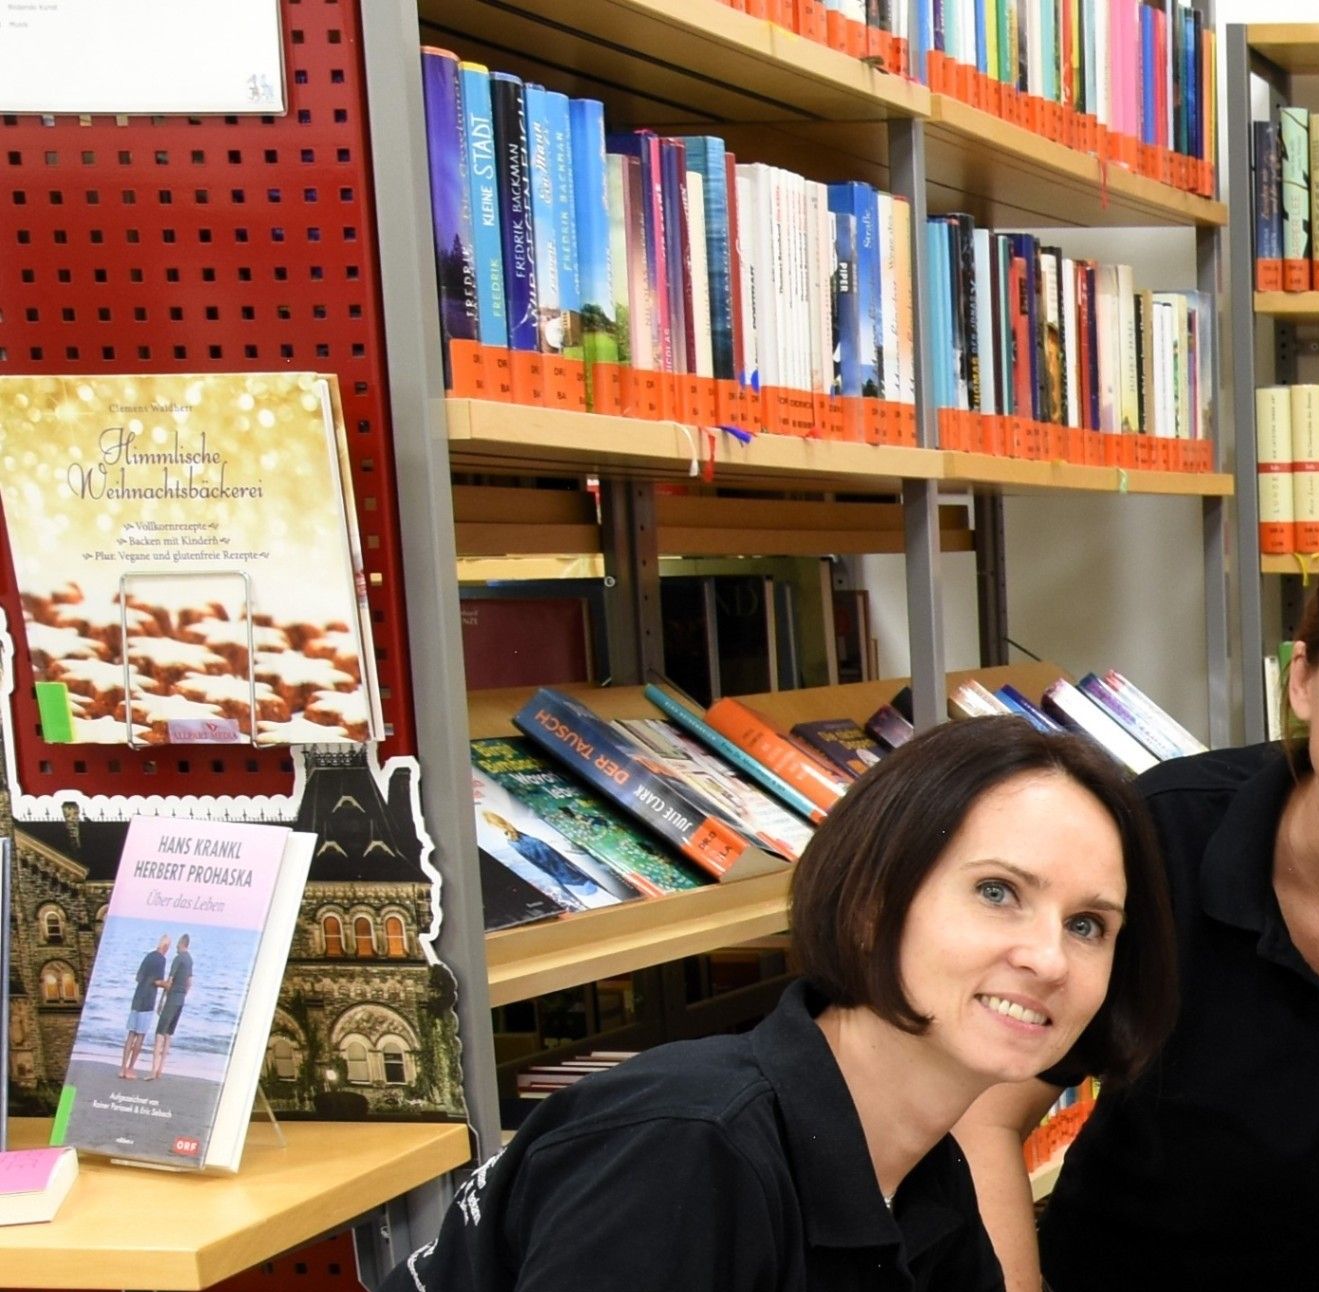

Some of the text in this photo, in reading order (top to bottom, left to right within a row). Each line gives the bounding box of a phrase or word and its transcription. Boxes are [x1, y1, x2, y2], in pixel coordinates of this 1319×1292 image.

[470, 112, 495, 227] KLEINE STADT
[508, 144, 526, 278] FREDRIK BACKMAN
[862, 209, 873, 249] Straße
[489, 259, 502, 317] FREDRIK
[840, 262, 849, 292] PIPER
[98, 427, 221, 466] Himmlische
[66, 460, 264, 501] Weihnachtsbäckerei
[129, 536, 161, 546] Backen
[163, 536, 179, 546] mit
[135, 521, 207, 534] Vollkornrezepte
[120, 549, 259, 564] Vegane und glutenfreie Rezepte
[533, 709, 595, 760] TAUSCH
[593, 753, 630, 786] DER
[632, 784, 693, 833] JULIE CLARK
[158, 835, 243, 860] HANS KRANKL
[133, 859, 254, 888] HERBERT PROHASKA
[146, 888, 226, 913] Über das Leben
[175, 1138, 199, 1152] ORF
